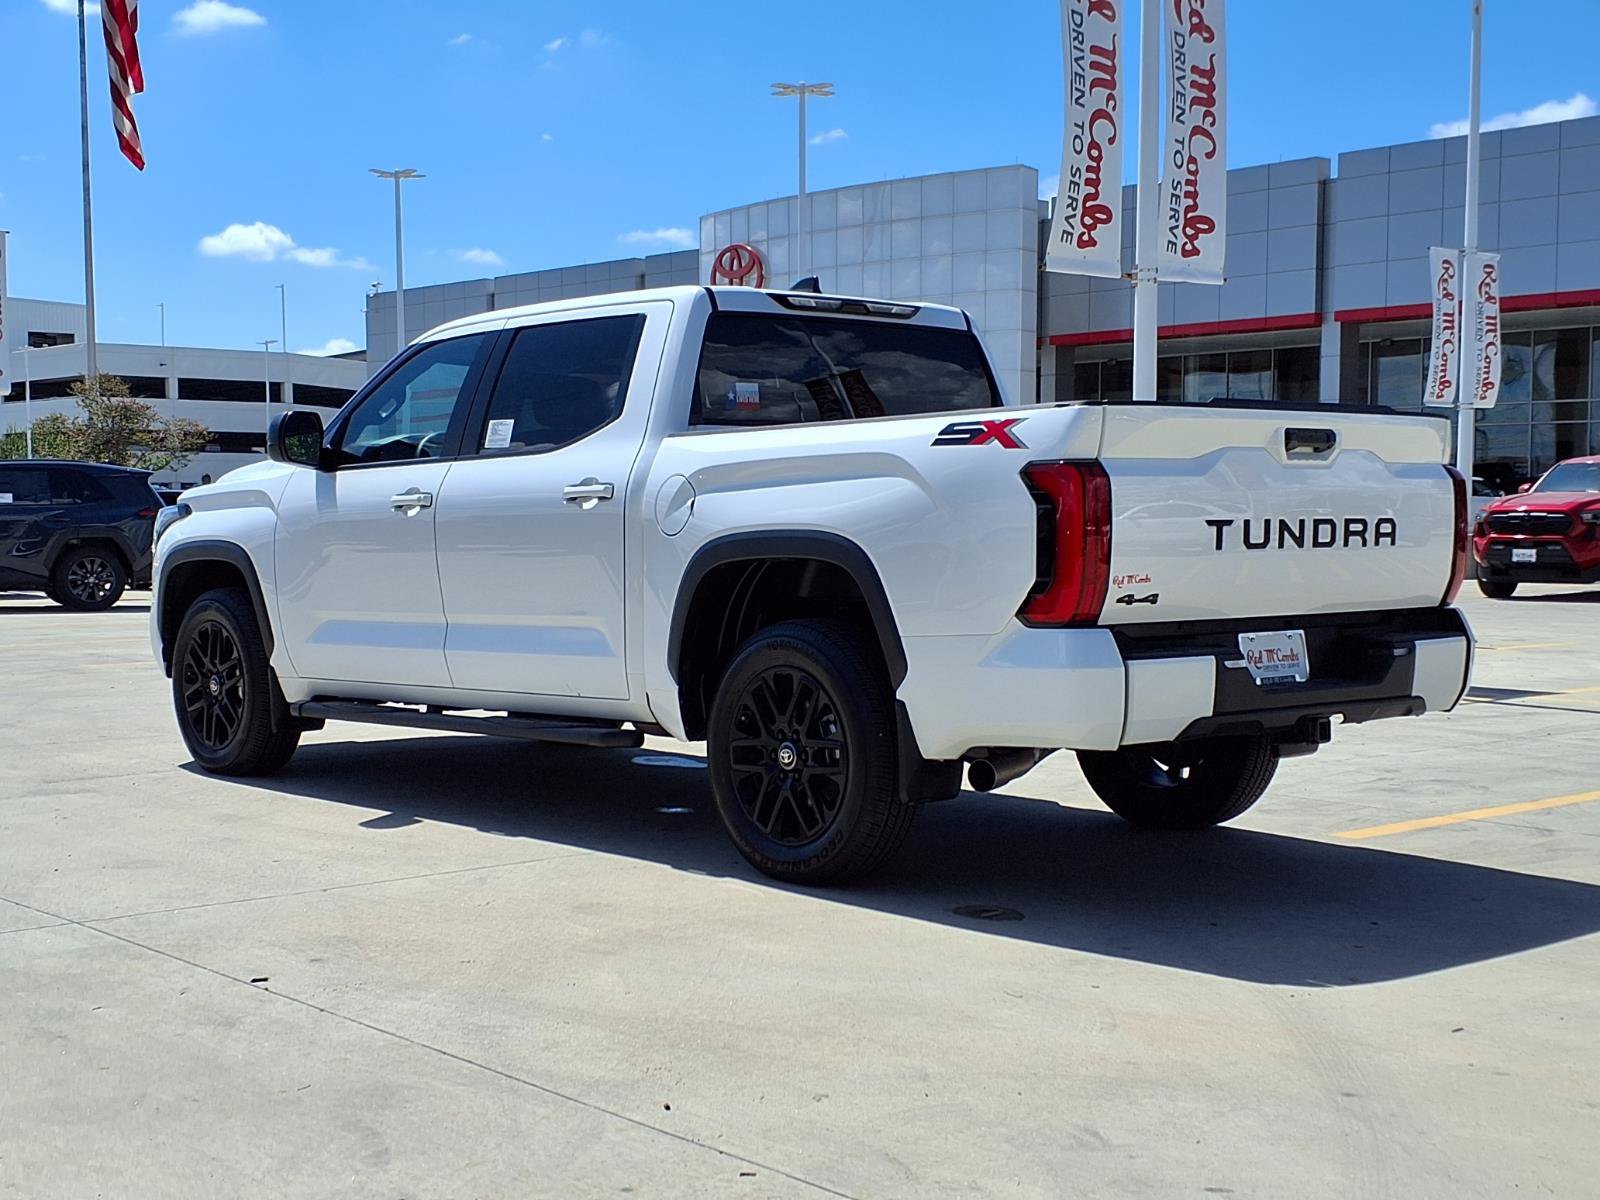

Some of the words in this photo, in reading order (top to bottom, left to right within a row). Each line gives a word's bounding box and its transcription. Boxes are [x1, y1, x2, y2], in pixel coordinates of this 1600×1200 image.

[1070, 9, 1086, 108] DRIVEN
[1172, 31, 1186, 125] DRIVEN
[1072, 120, 1085, 156] TO
[1076, 33, 1117, 249] McCombs
[1173, 137, 1185, 170] TO
[1181, 53, 1217, 258] McCombs
[1060, 165, 1082, 246] SERVE
[1166, 178, 1182, 255] SERVE
[1437, 259, 1455, 301] Red
[1478, 263, 1497, 305] Red
[1475, 301, 1484, 342] DRIVEN
[1434, 345, 1441, 360] TO
[1435, 304, 1455, 400] McCombs
[1475, 348, 1483, 362] TO
[1479, 307, 1499, 400] McCombs
[1428, 363, 1440, 399] SERVE
[1473, 366, 1483, 399] SERVE
[1204, 517, 1397, 551] TUNDRA
[1112, 575, 1125, 589] Red
[1246, 649, 1263, 670] Red
